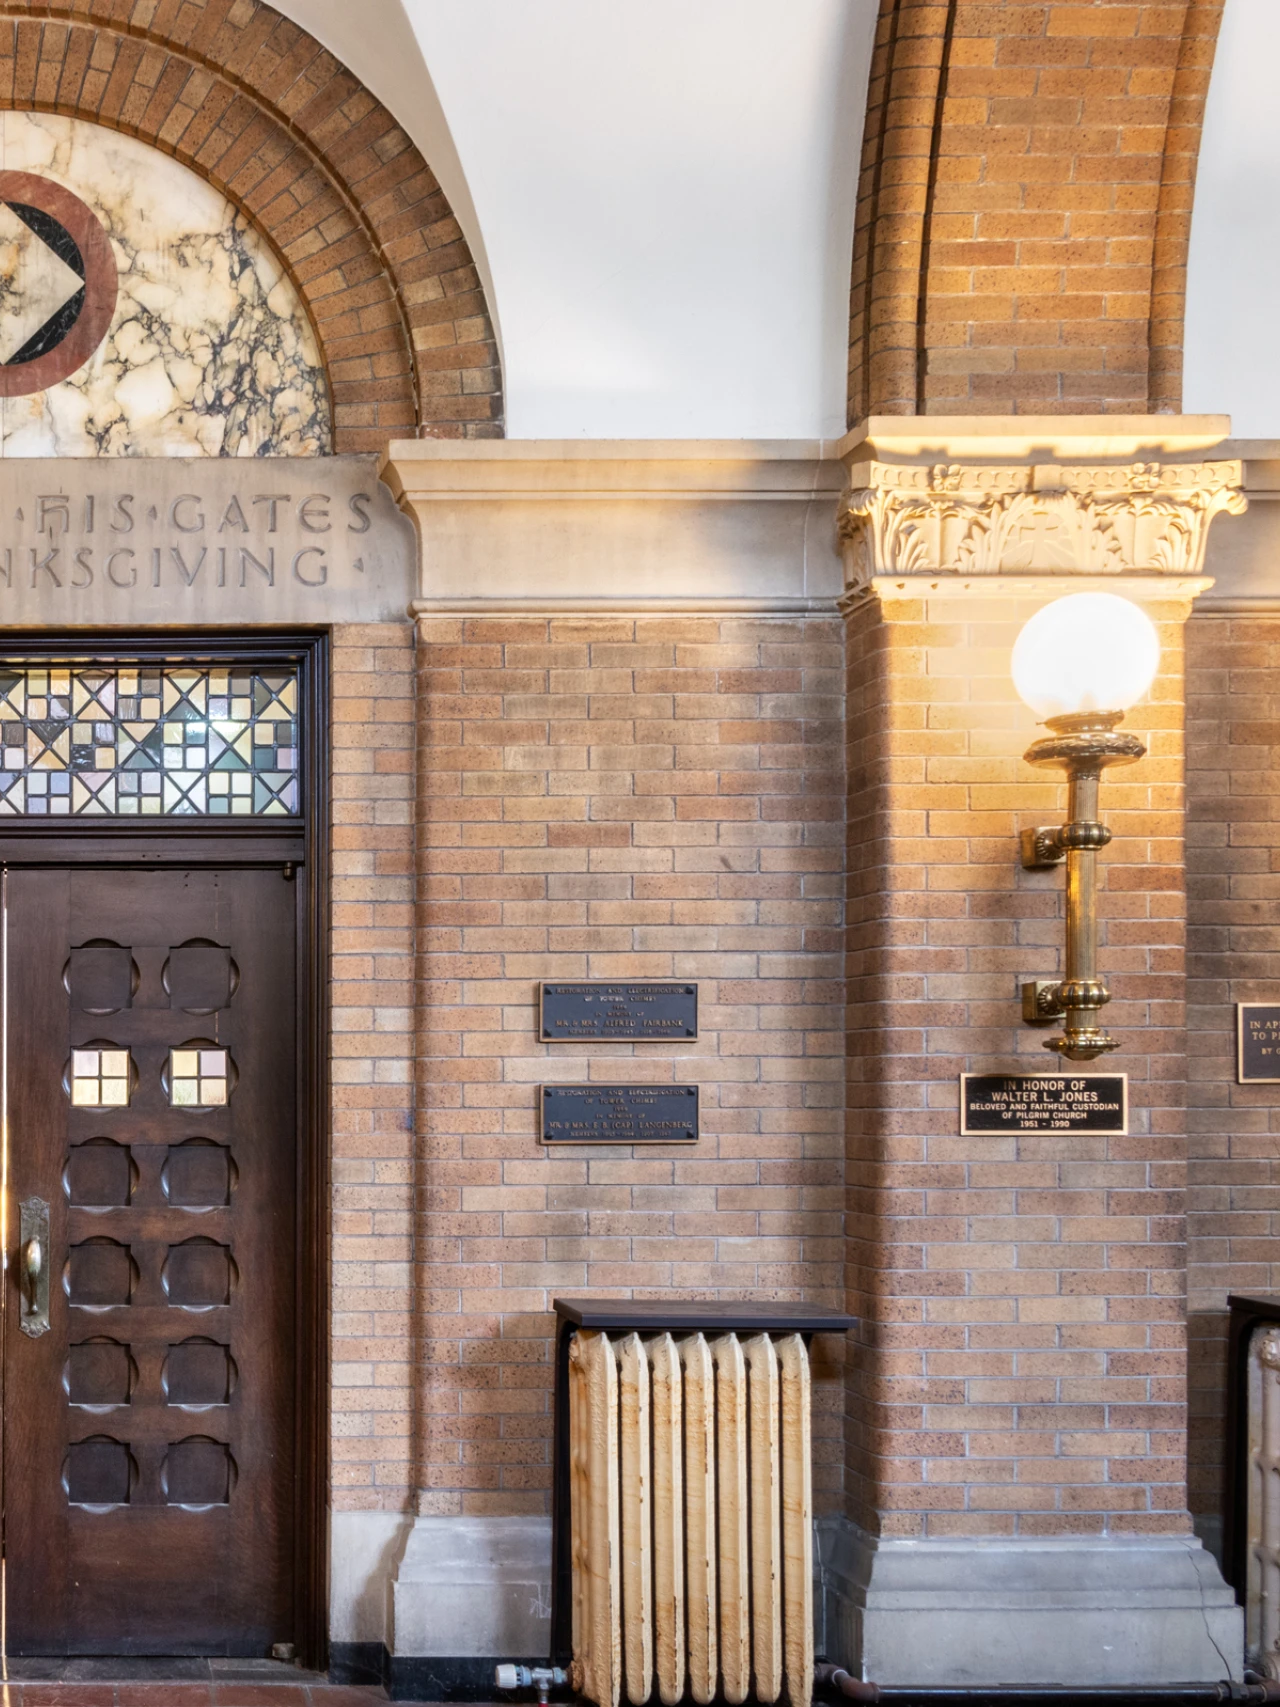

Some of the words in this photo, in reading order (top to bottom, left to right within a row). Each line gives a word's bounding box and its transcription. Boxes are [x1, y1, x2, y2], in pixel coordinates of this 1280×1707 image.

[169, 493, 374, 535] GATES
[604, 1019, 636, 1027] ALFRED
[643, 1019, 684, 1027] FAIRBANK
[1249, 1021, 1261, 1029] IN
[1252, 1032, 1267, 1040] TO
[1003, 1080, 1017, 1091] IN
[1022, 1080, 1065, 1091] HONOR
[1070, 1080, 1086, 1091] OF
[992, 1092, 1038, 1102] WALTER
[1043, 1092, 1054, 1102] L.
[1059, 1092, 1098, 1102] JONES
[1072, 1103, 1119, 1111] CUSTODIAN
[1020, 1120, 1038, 1128] 1951
[1050, 1120, 1070, 1128] 1990
